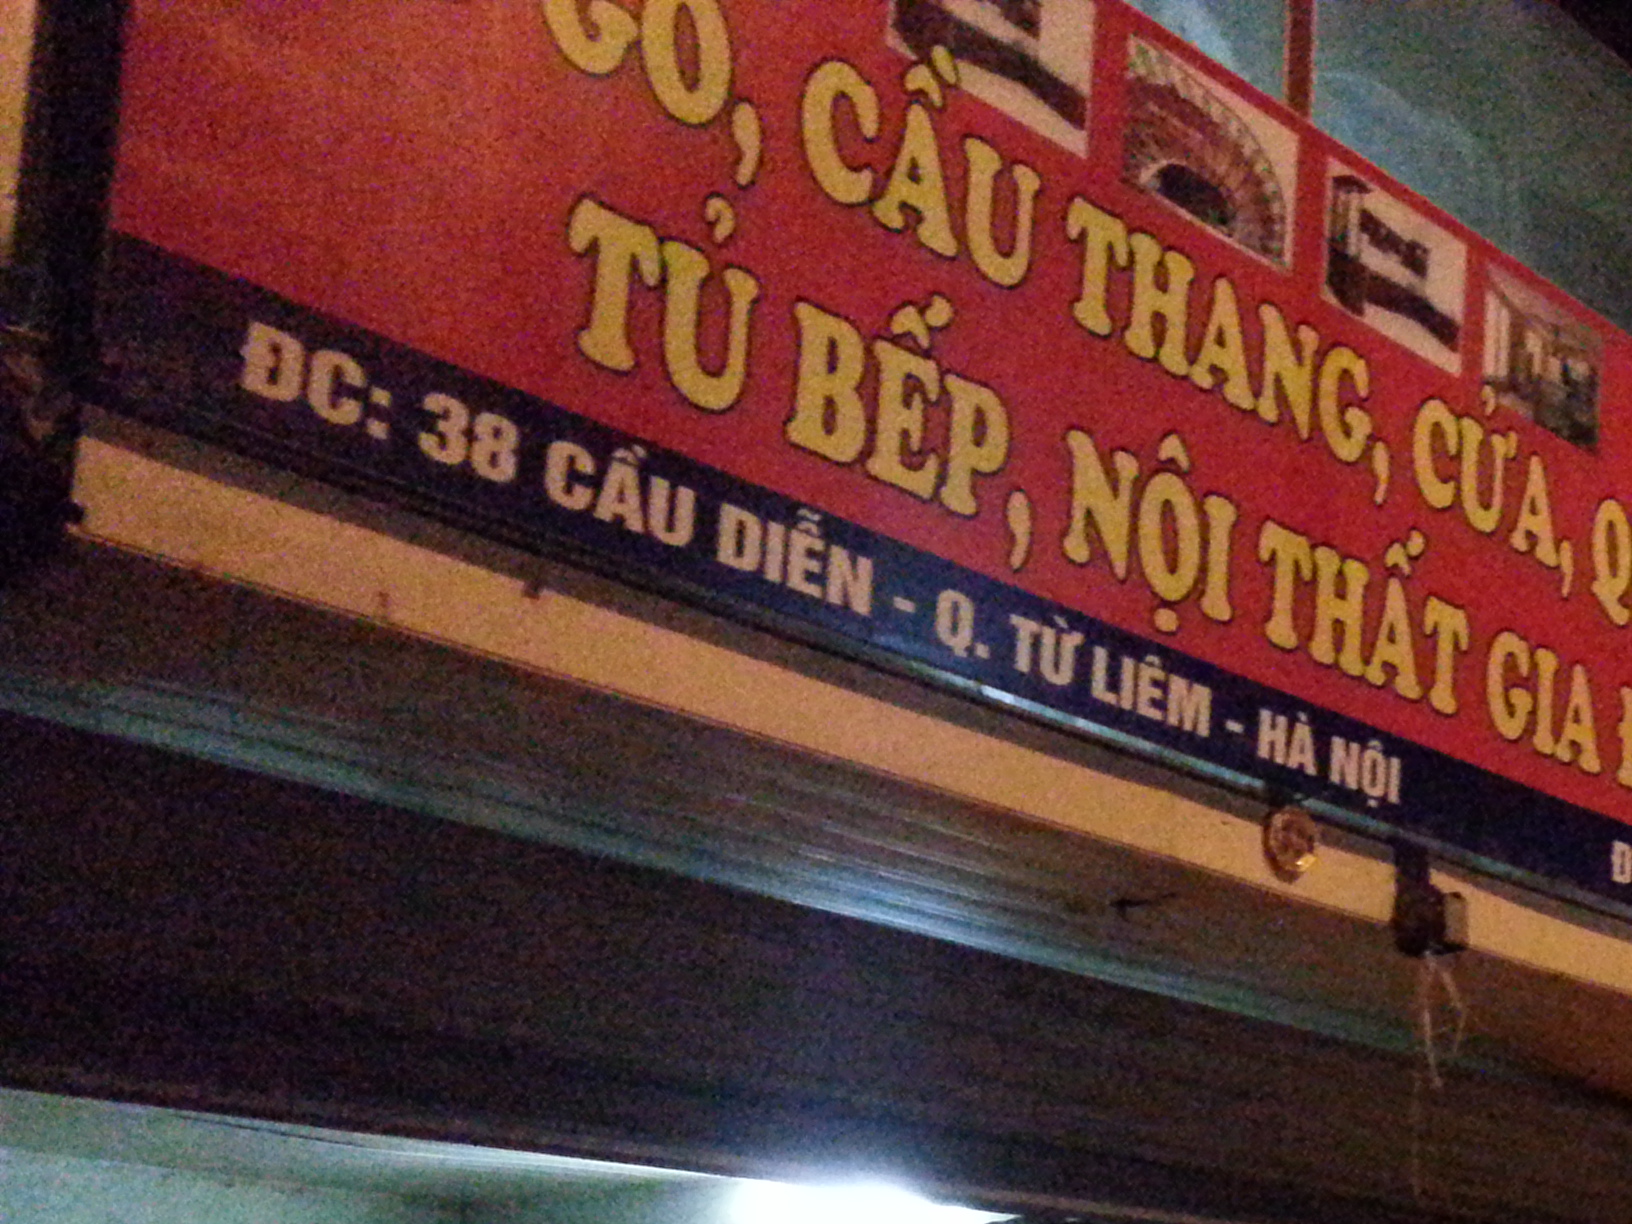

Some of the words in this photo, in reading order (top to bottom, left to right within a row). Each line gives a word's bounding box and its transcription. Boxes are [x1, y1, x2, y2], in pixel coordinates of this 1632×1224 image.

[239, 321, 392, 440] ĐC:
[418, 391, 518, 484] 38
[542, 445, 697, 548] CẦU
[717, 509, 875, 617] DIỄN
[935, 586, 990, 661] Q.
[1010, 608, 1084, 688] TỪ
[1091, 653, 1212, 738] LIÊM
[1257, 703, 1317, 775] HÀ
[1330, 746, 1401, 811] NỘI
[567, 192, 759, 411] TỦ
[783, 293, 1033, 573] BẾP,
[1061, 428, 1238, 633] NỘI
[1257, 521, 1469, 716] THẤT
[1486, 630, 1601, 775] GIA
[800, 43, 1041, 287] CẦU
[1066, 195, 1391, 505] THANG,
[1412, 384, 1574, 598] CỬA,
